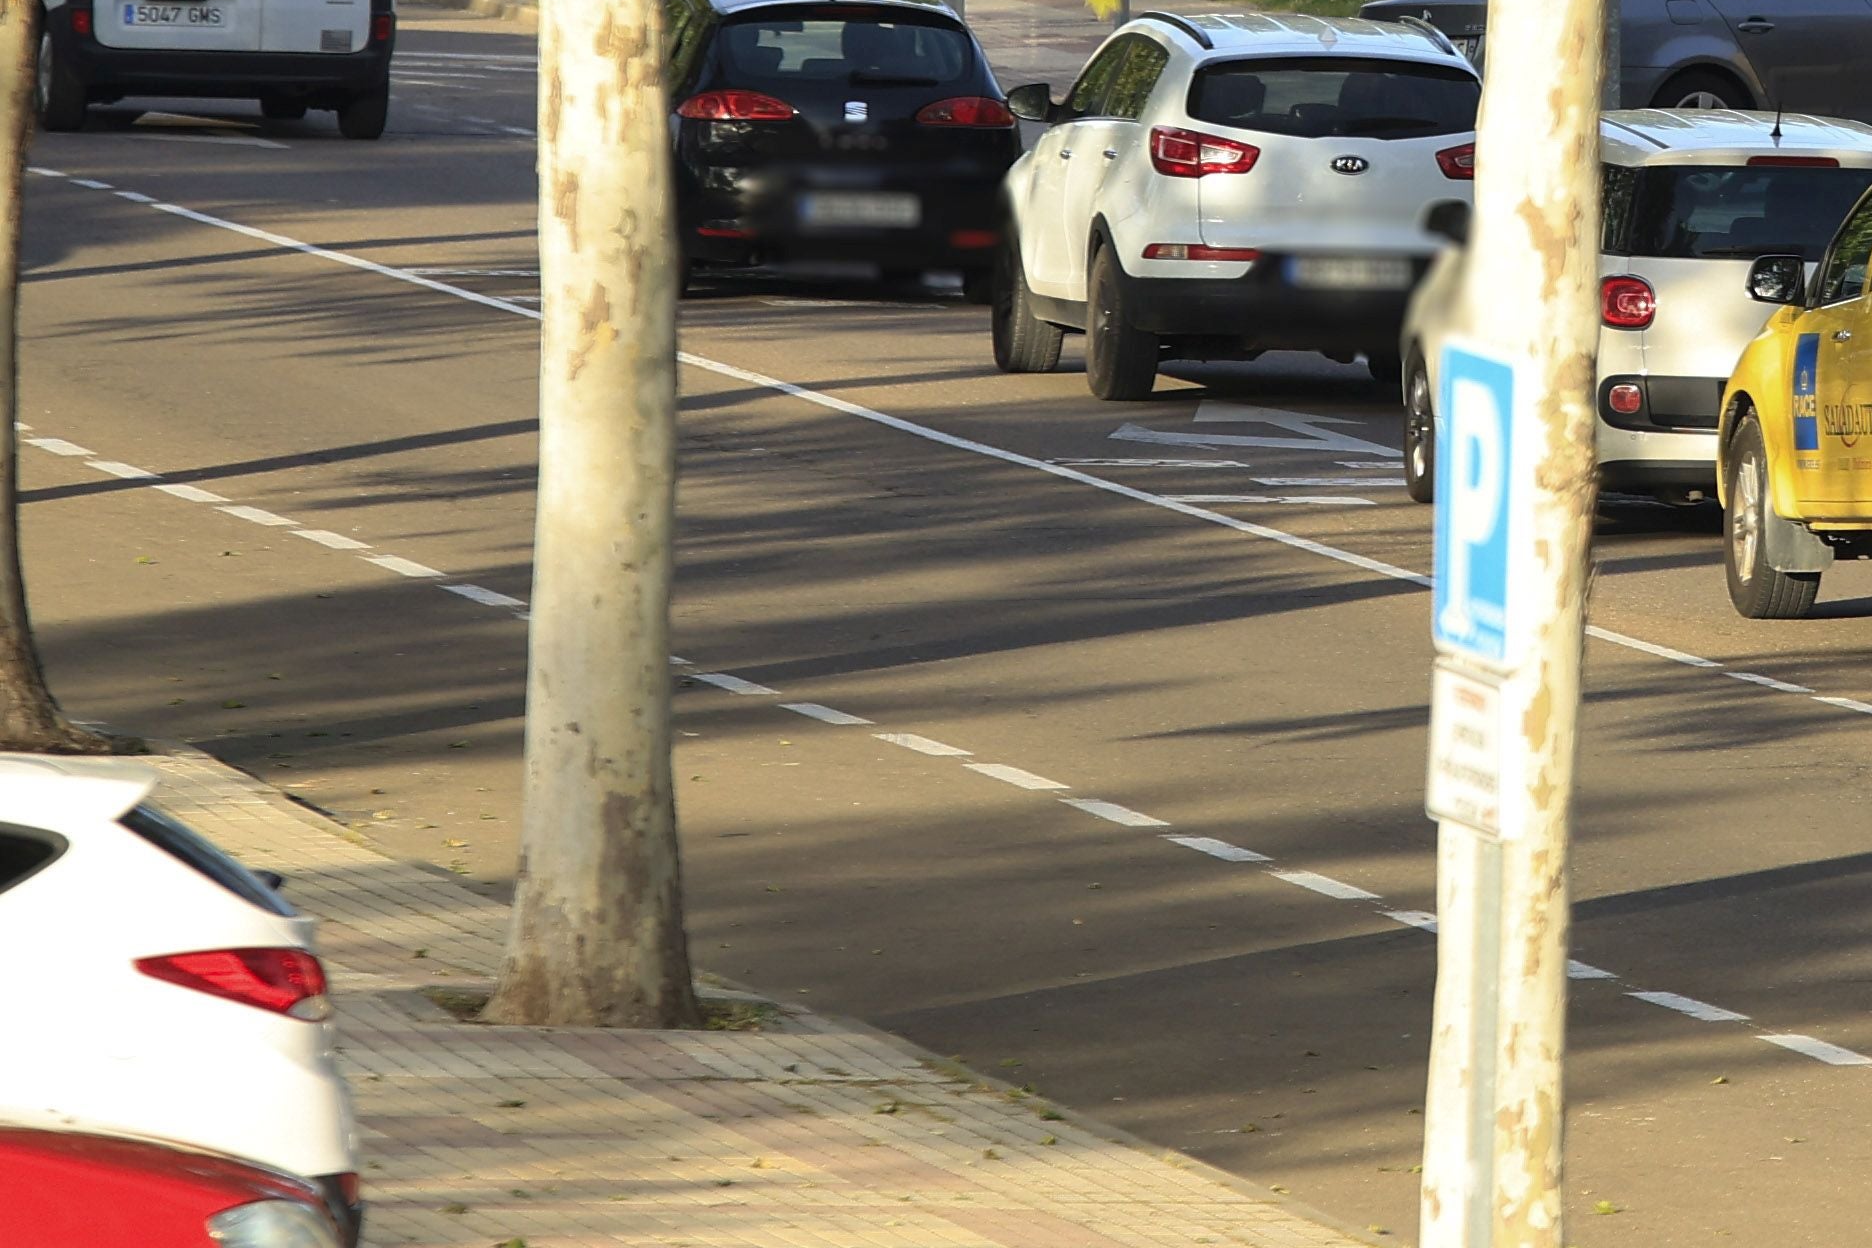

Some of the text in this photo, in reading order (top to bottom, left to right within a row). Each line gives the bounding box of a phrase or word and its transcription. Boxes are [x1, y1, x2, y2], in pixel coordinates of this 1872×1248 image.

[137, 6, 182, 22] 5047
[1336, 159, 1363, 170] KIA
[1794, 394, 1816, 418] RACE
[1446, 377, 1500, 624] P
